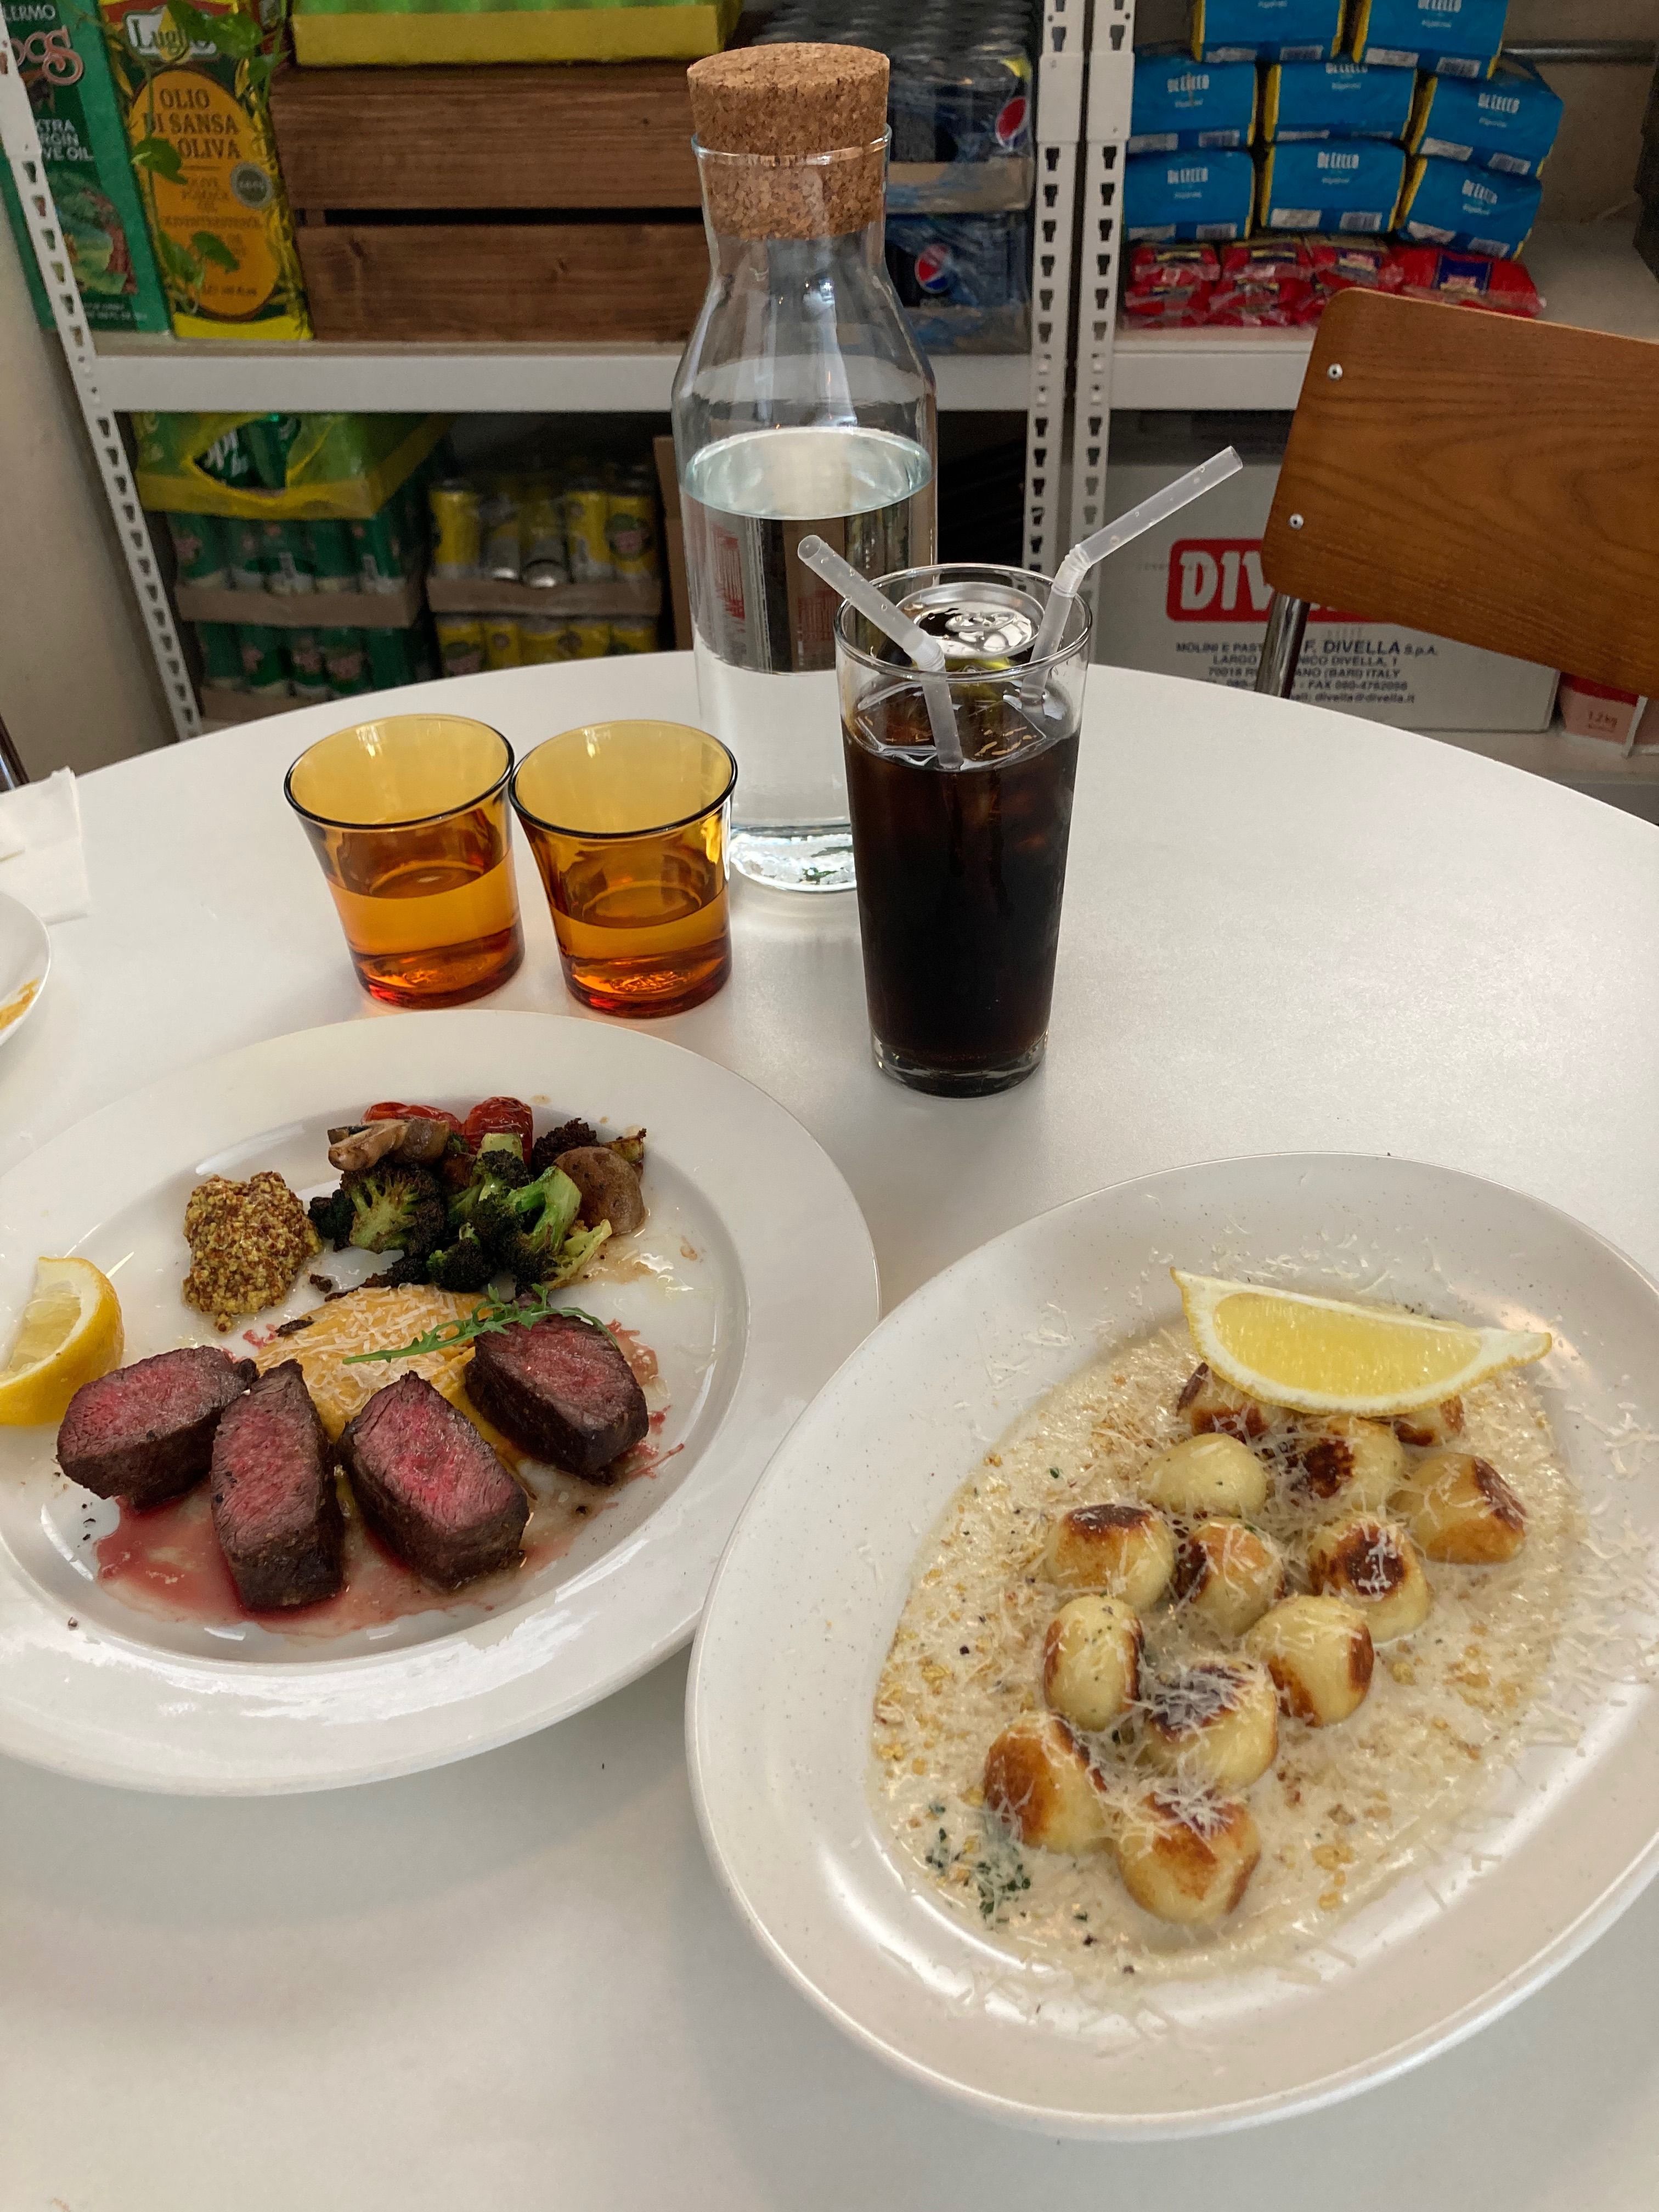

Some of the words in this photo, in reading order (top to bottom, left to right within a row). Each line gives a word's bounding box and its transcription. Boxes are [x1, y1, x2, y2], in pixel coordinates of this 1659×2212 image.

[160, 88, 210, 109] OLIO
[168, 112, 240, 134] SANSA
[177, 138, 242, 159] OLIVA
[1323, 639, 1400, 654] DIVELLA
